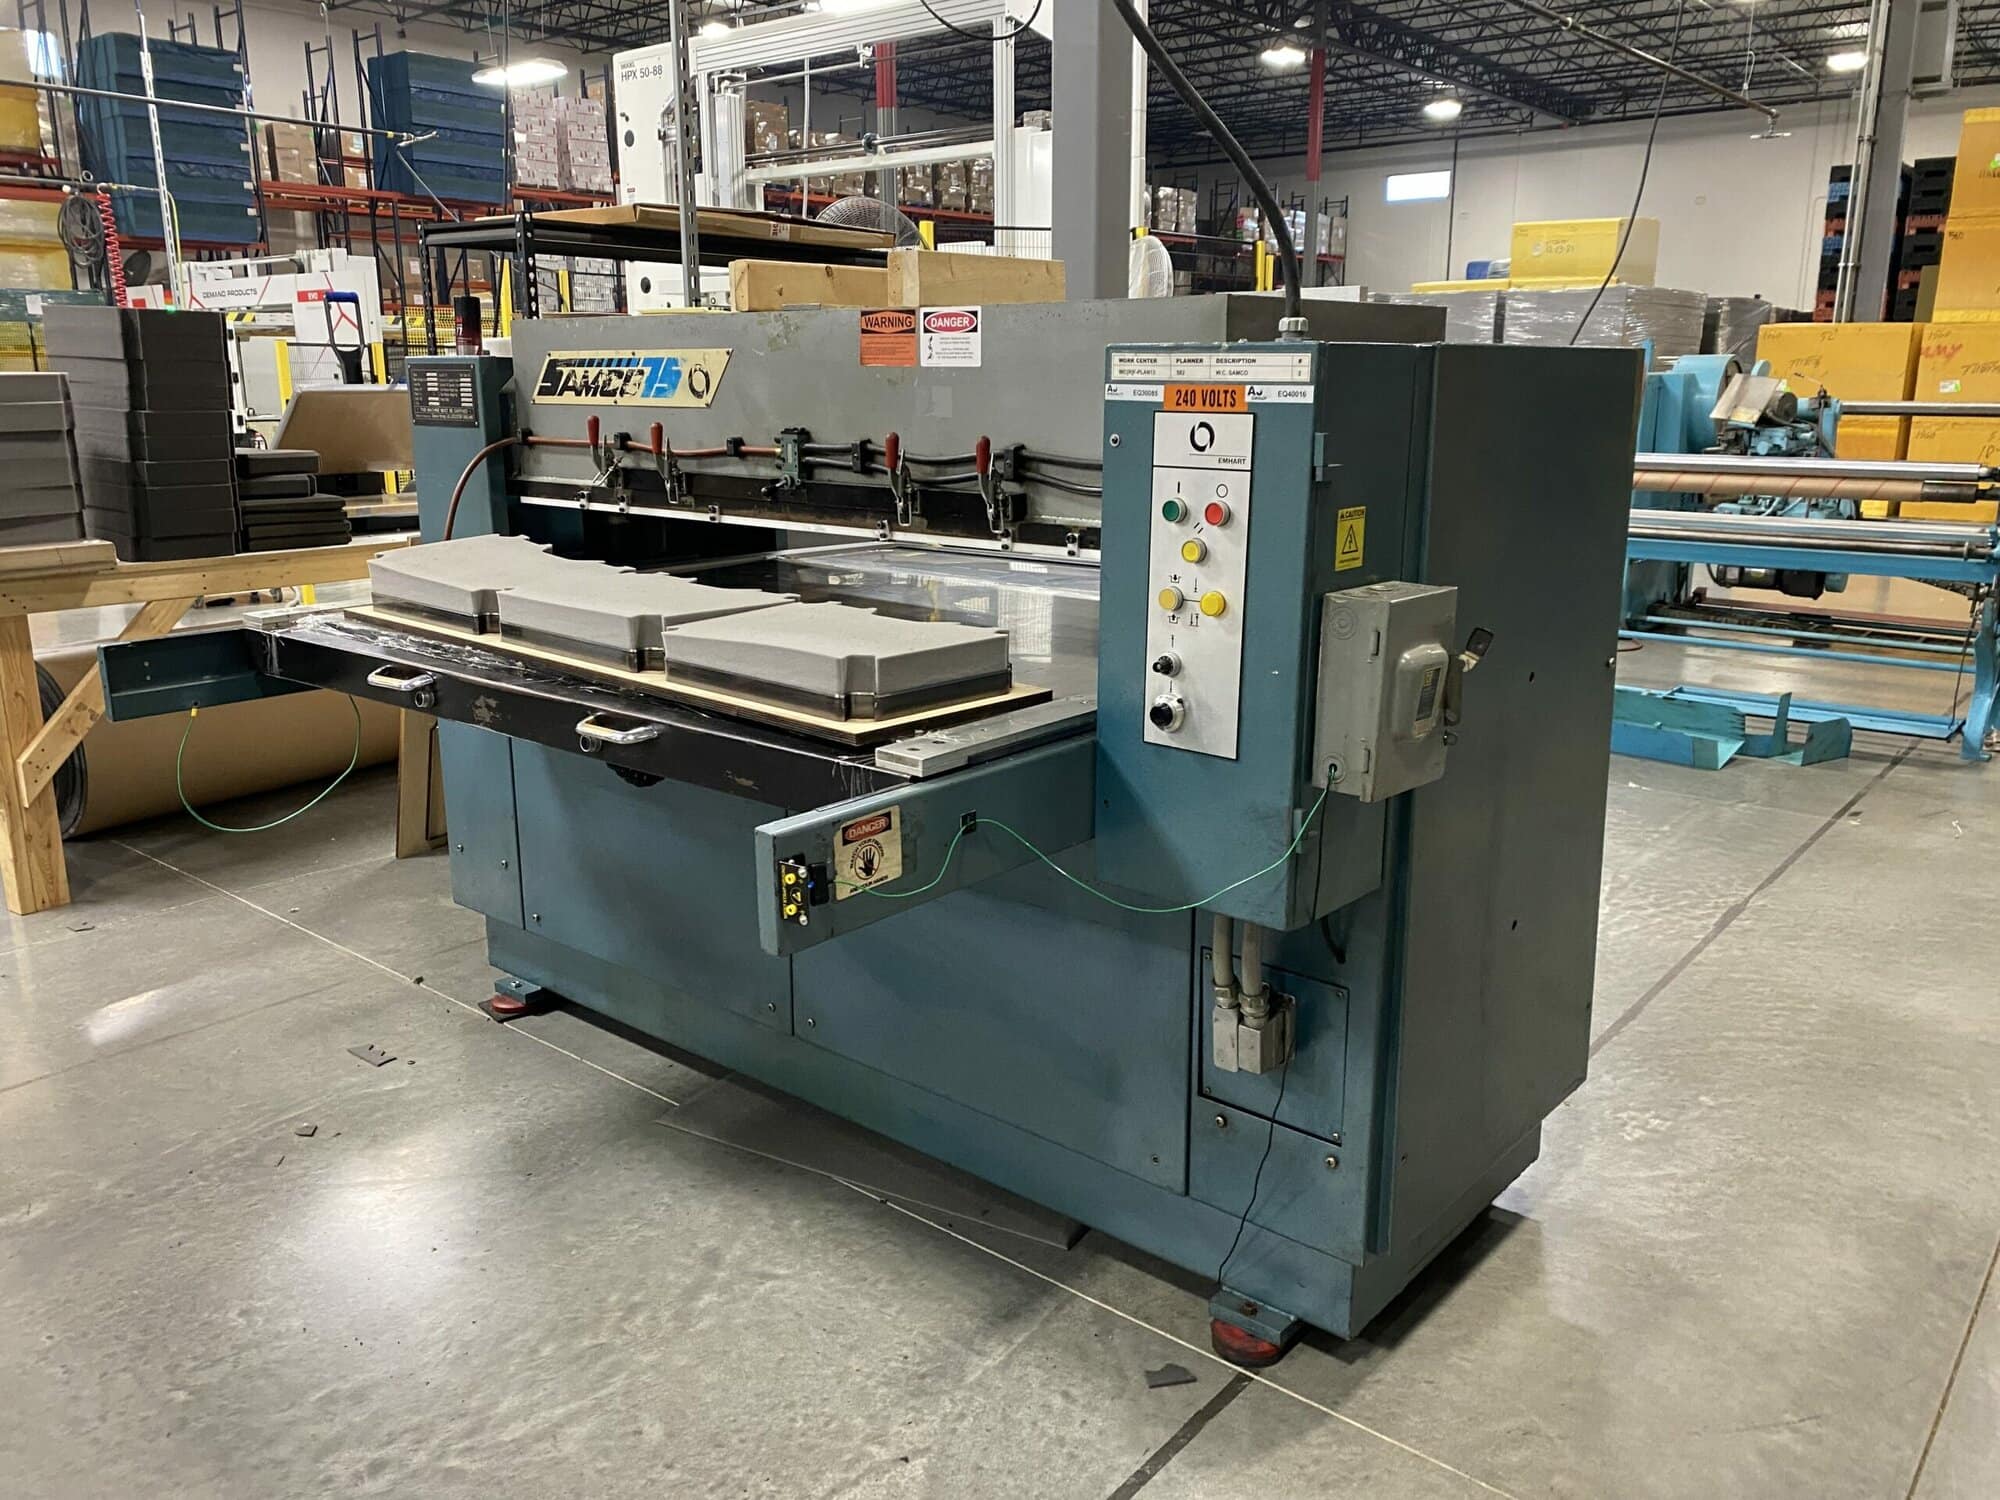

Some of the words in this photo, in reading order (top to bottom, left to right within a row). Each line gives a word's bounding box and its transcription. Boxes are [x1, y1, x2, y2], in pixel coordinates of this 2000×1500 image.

[621, 69, 638, 81] HPX
[203, 291, 226, 299] DEMAND
[227, 288, 257, 296] PRODUCTS
[864, 316, 912, 329] WARNING
[931, 317, 970, 328] DANGER
[1175, 389, 1196, 407] 240
[1201, 389, 1237, 408] VOLTS
[1218, 457, 1246, 465] EMHART
[848, 818, 886, 838] DANGER
